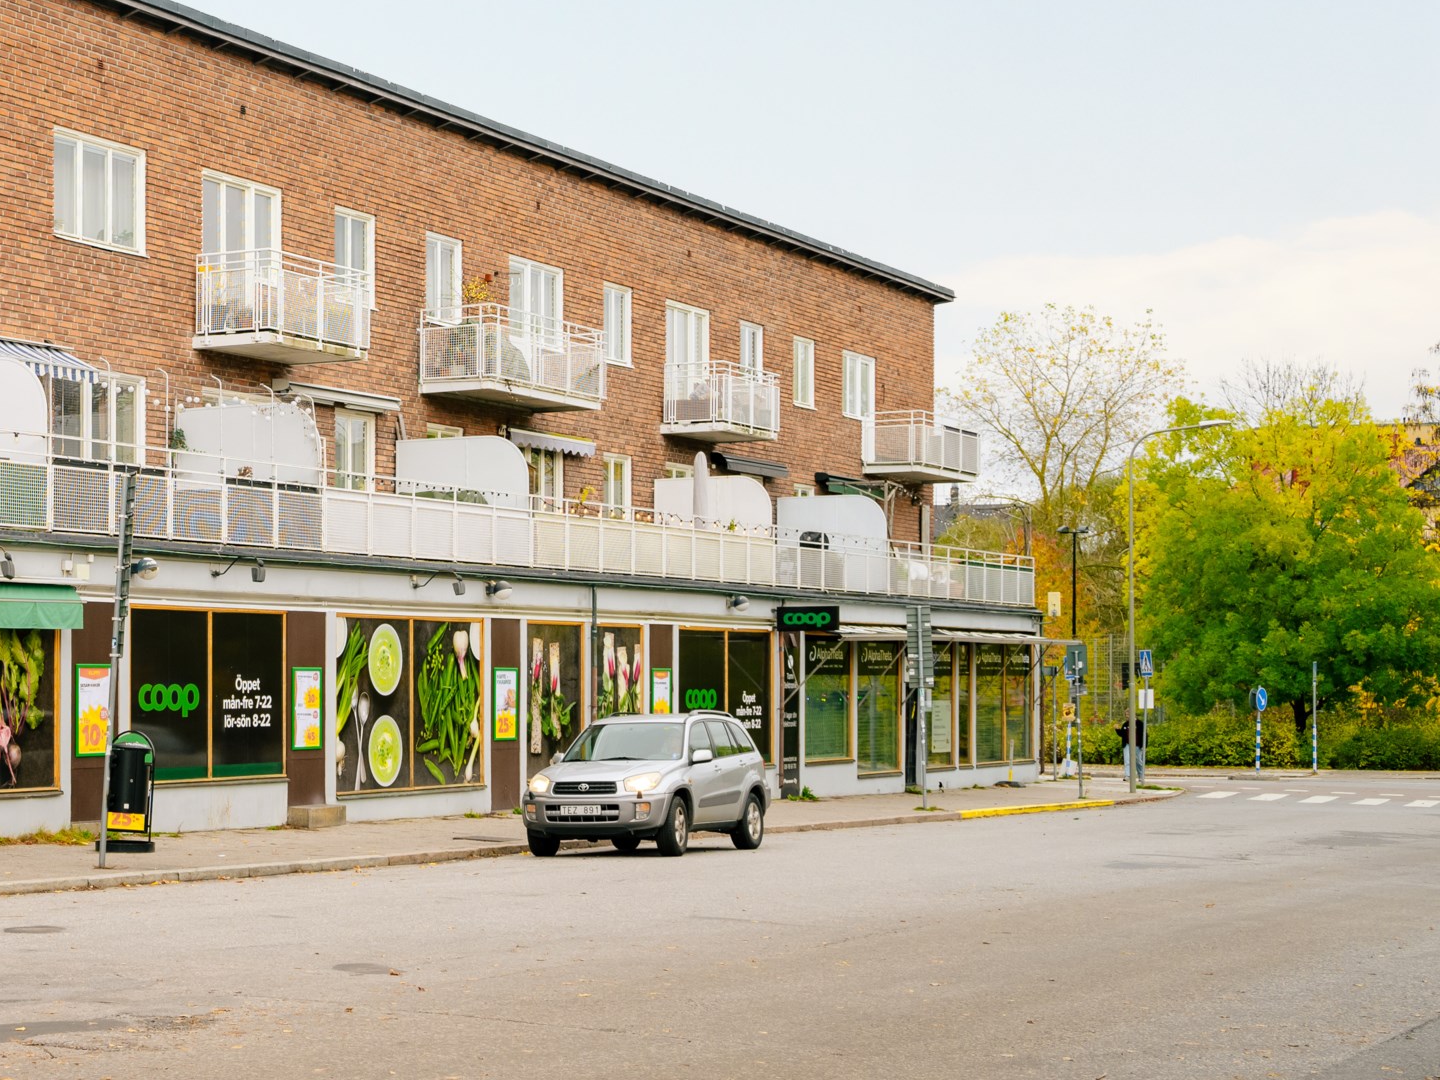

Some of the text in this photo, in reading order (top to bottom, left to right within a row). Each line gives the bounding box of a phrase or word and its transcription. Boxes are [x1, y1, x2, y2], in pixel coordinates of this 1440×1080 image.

[783, 611, 831, 628] coop
[234, 674, 260, 693] Öppet
[138, 683, 200, 717] coop
[222, 694, 272, 709] mån-fre 7-22
[685, 688, 717, 710] coop
[742, 690, 756, 704] Öppet
[735, 705, 762, 716] mån-fre 7-22
[223, 714, 271, 728] lör-sön 8-22
[562, 806, 599, 815] TEZ 891
